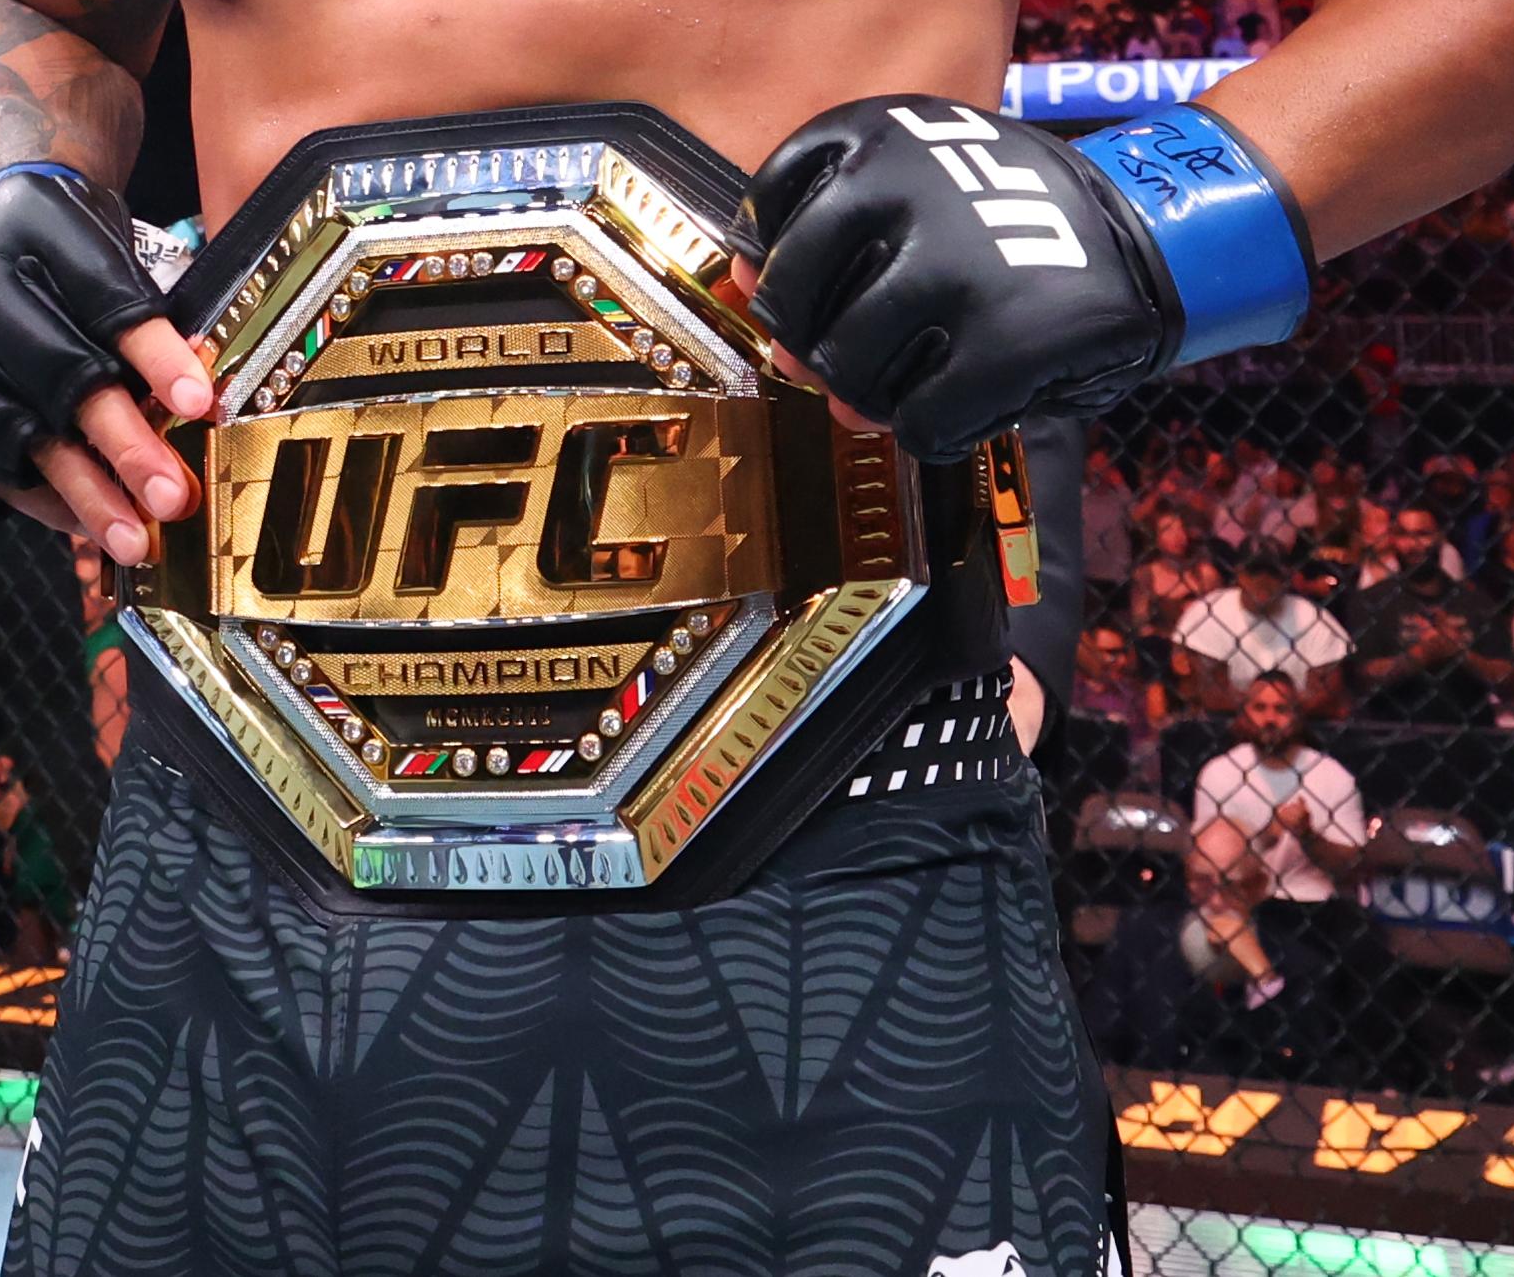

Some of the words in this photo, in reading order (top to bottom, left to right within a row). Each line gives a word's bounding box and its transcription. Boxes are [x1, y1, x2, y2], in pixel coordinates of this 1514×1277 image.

[887, 106, 1088, 268] UFC
[368, 329, 574, 366] WORLD
[251, 412, 690, 599] UFC
[343, 654, 621, 686] CHAMPION
